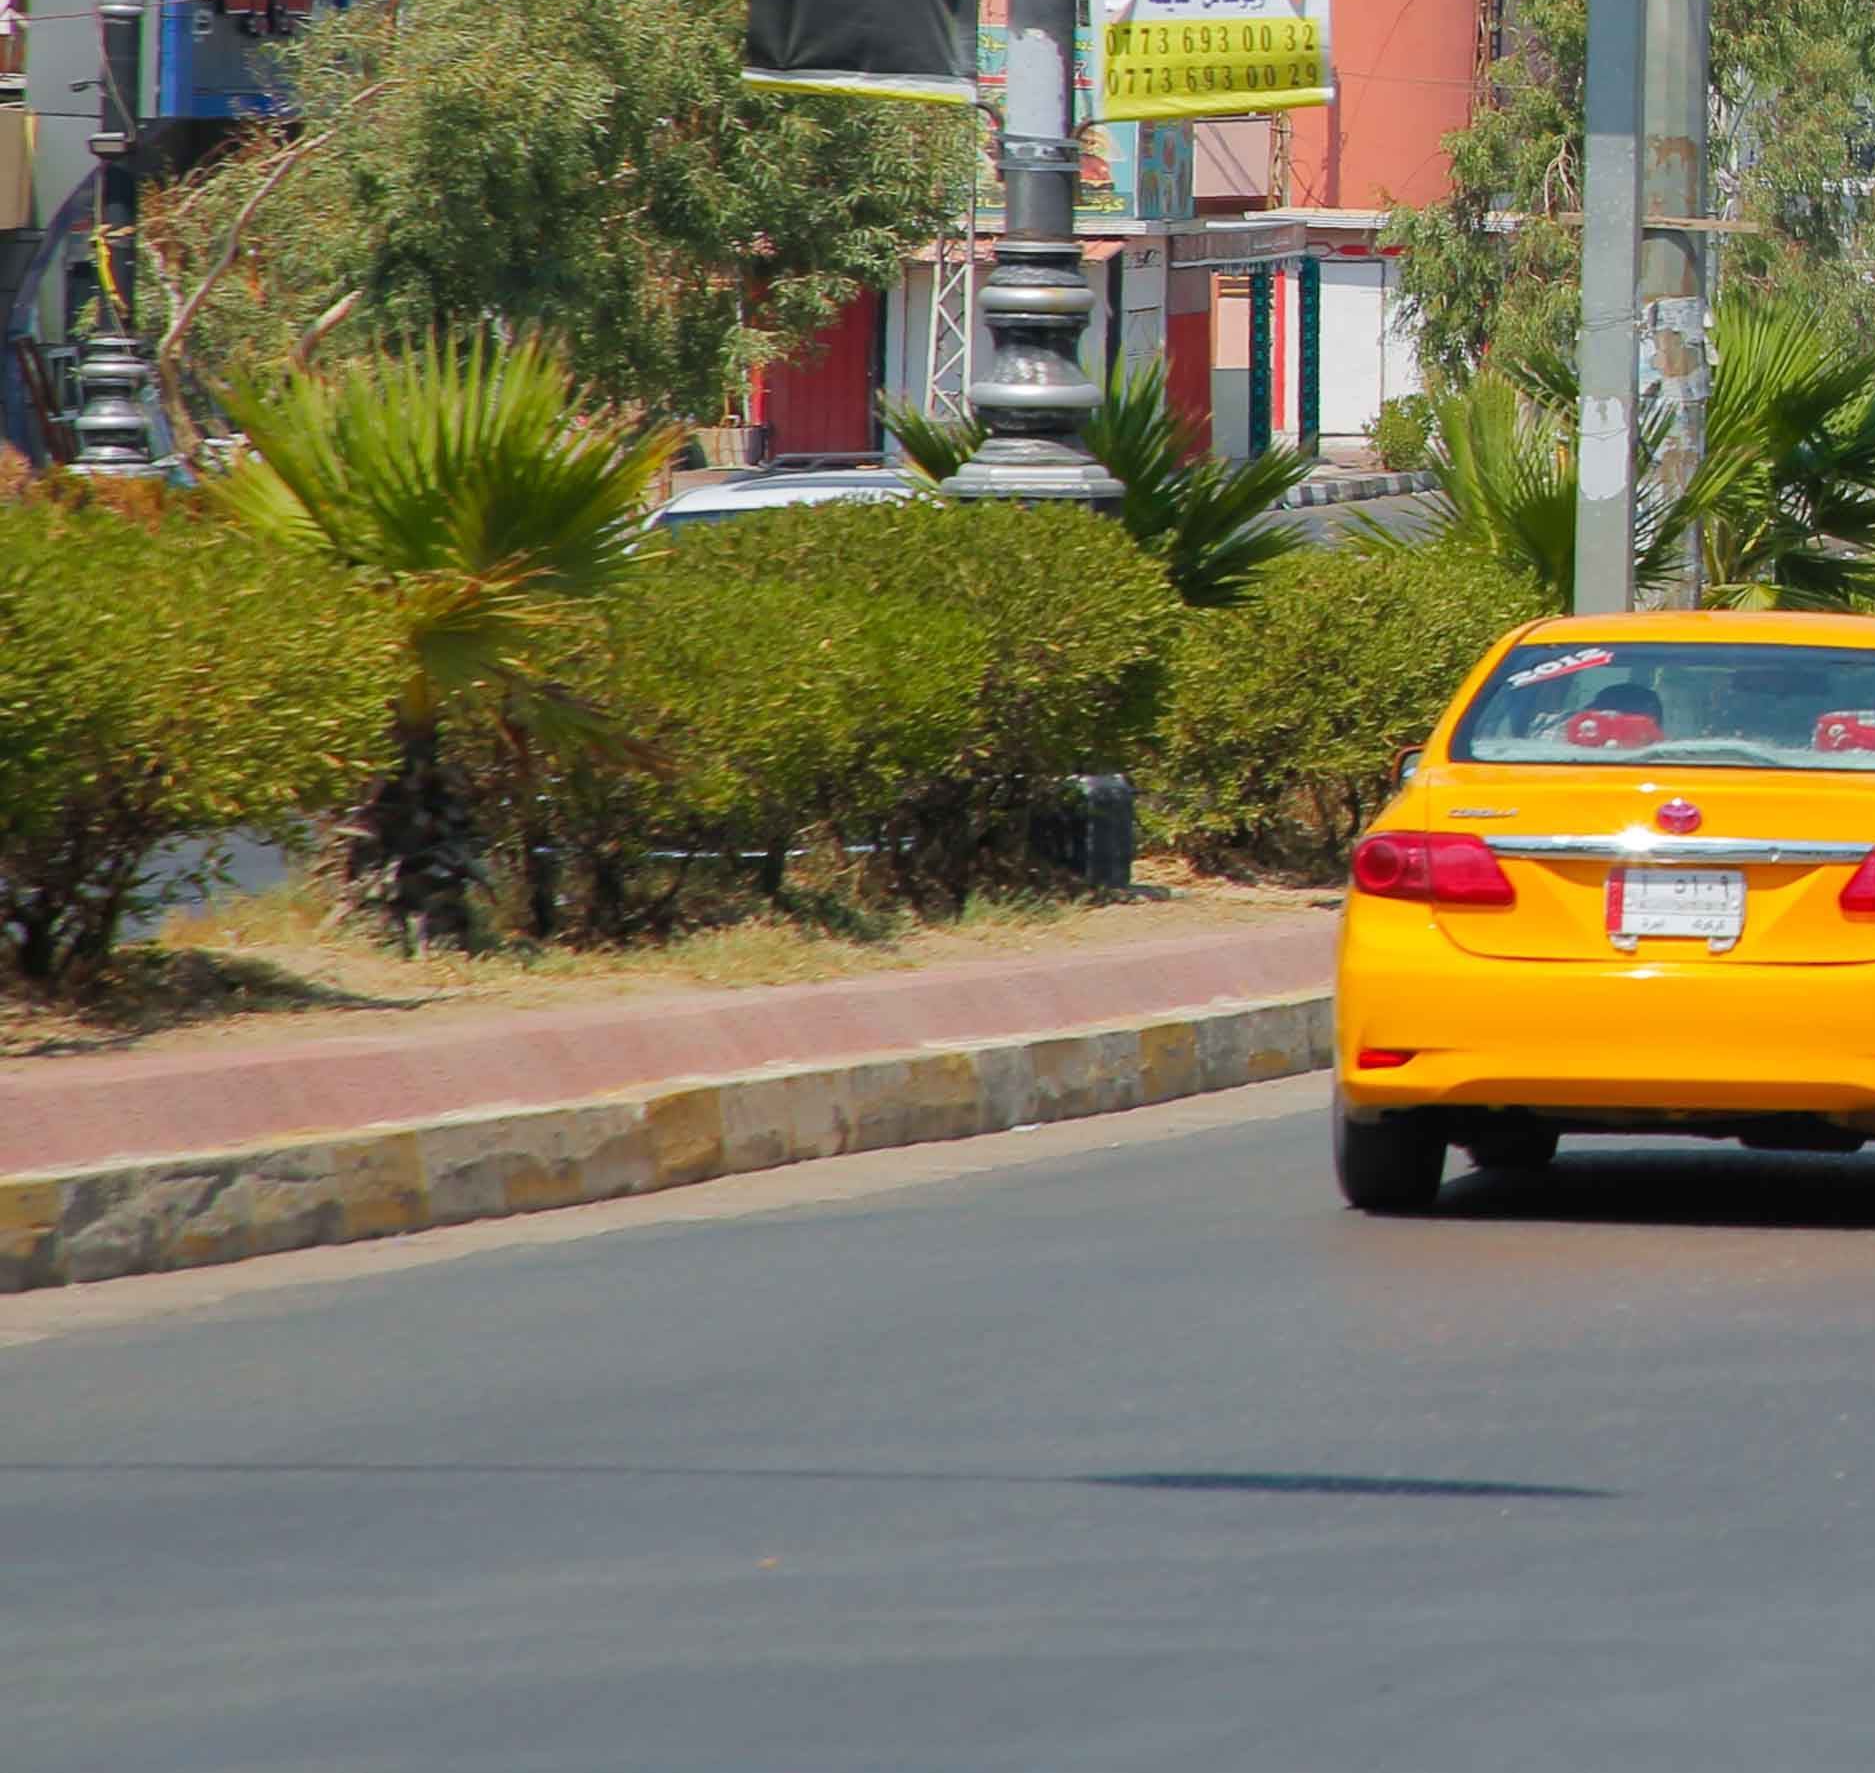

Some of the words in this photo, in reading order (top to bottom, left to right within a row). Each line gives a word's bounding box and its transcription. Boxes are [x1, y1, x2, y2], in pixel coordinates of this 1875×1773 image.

[1105, 28, 1169, 56] 0773
[1183, 26, 1229, 54] 693
[1243, 25, 1271, 53] 00
[1286, 24, 1314, 51] 32
[1107, 67, 1173, 95] 0773
[1187, 65, 1233, 93] 693
[1247, 64, 1276, 89] 00
[1290, 63, 1318, 87] 29
